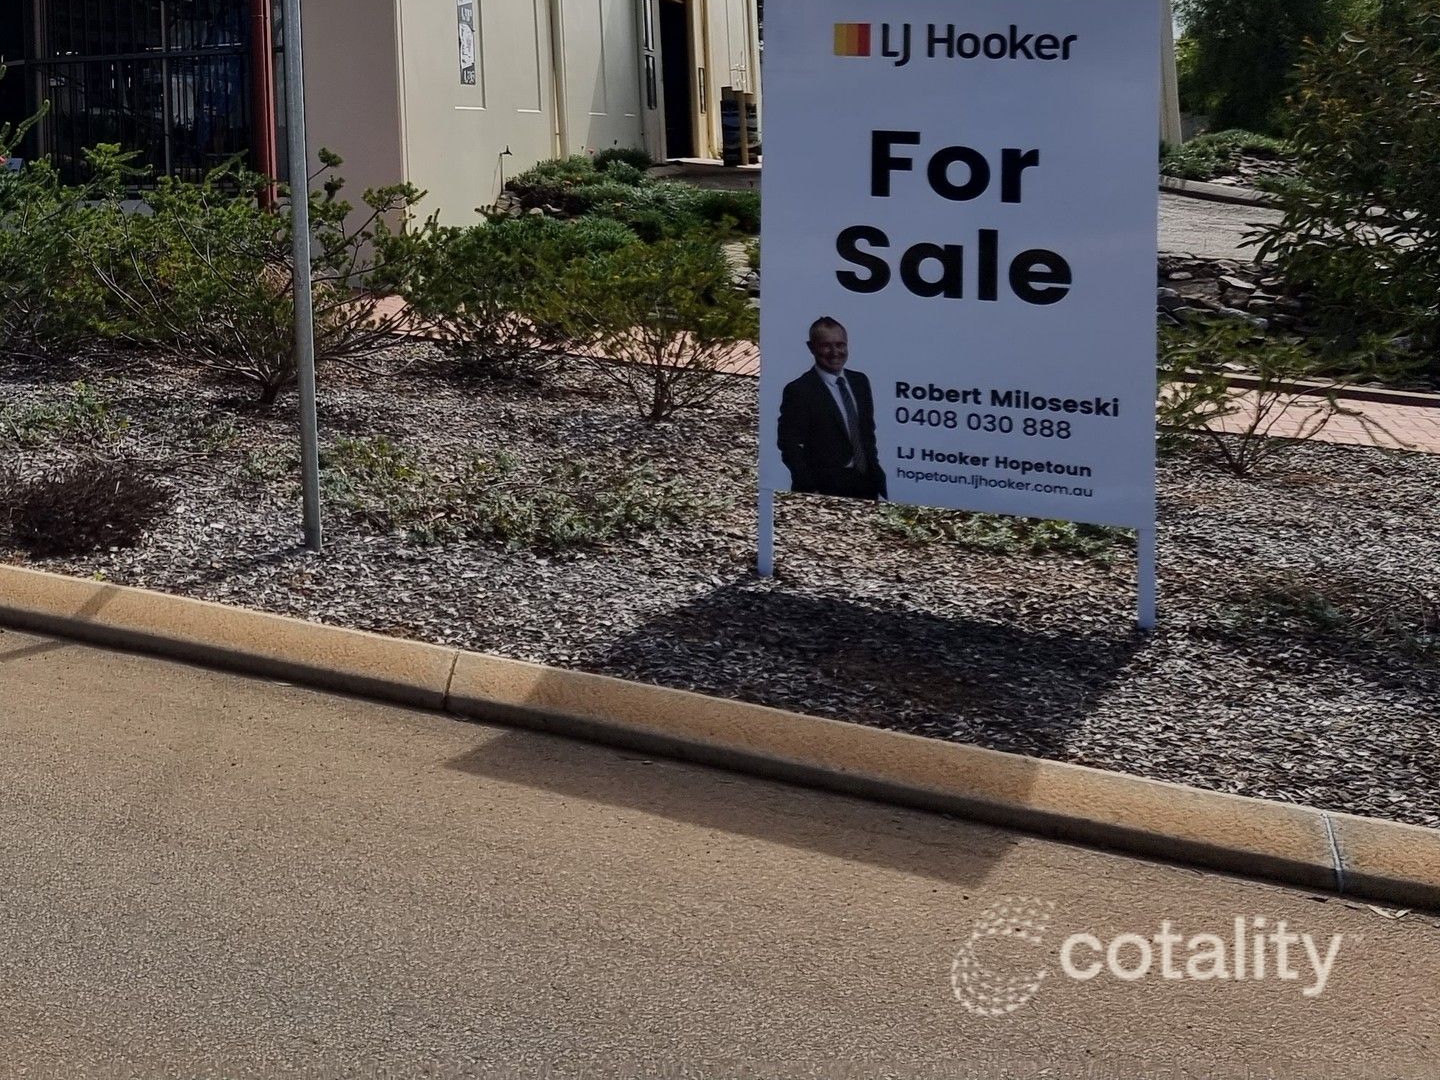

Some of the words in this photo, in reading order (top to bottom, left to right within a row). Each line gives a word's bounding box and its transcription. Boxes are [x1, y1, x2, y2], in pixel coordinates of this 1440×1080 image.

[882, 23, 911, 67] LJ
[927, 23, 1078, 62] Hooker
[870, 129, 1040, 204] For
[835, 224, 1073, 306] Sale
[895, 380, 982, 405] Robert
[990, 389, 1120, 418] Miloseski
[895, 406, 958, 429] 0408
[966, 412, 1014, 434] 030
[1022, 417, 1072, 440] 888
[897, 446, 915, 460] LJ
[921, 448, 990, 468] Hooker
[995, 455, 1092, 478] Hopetoun
[896, 467, 1093, 498] hopetoun.ljhooker.com.au
